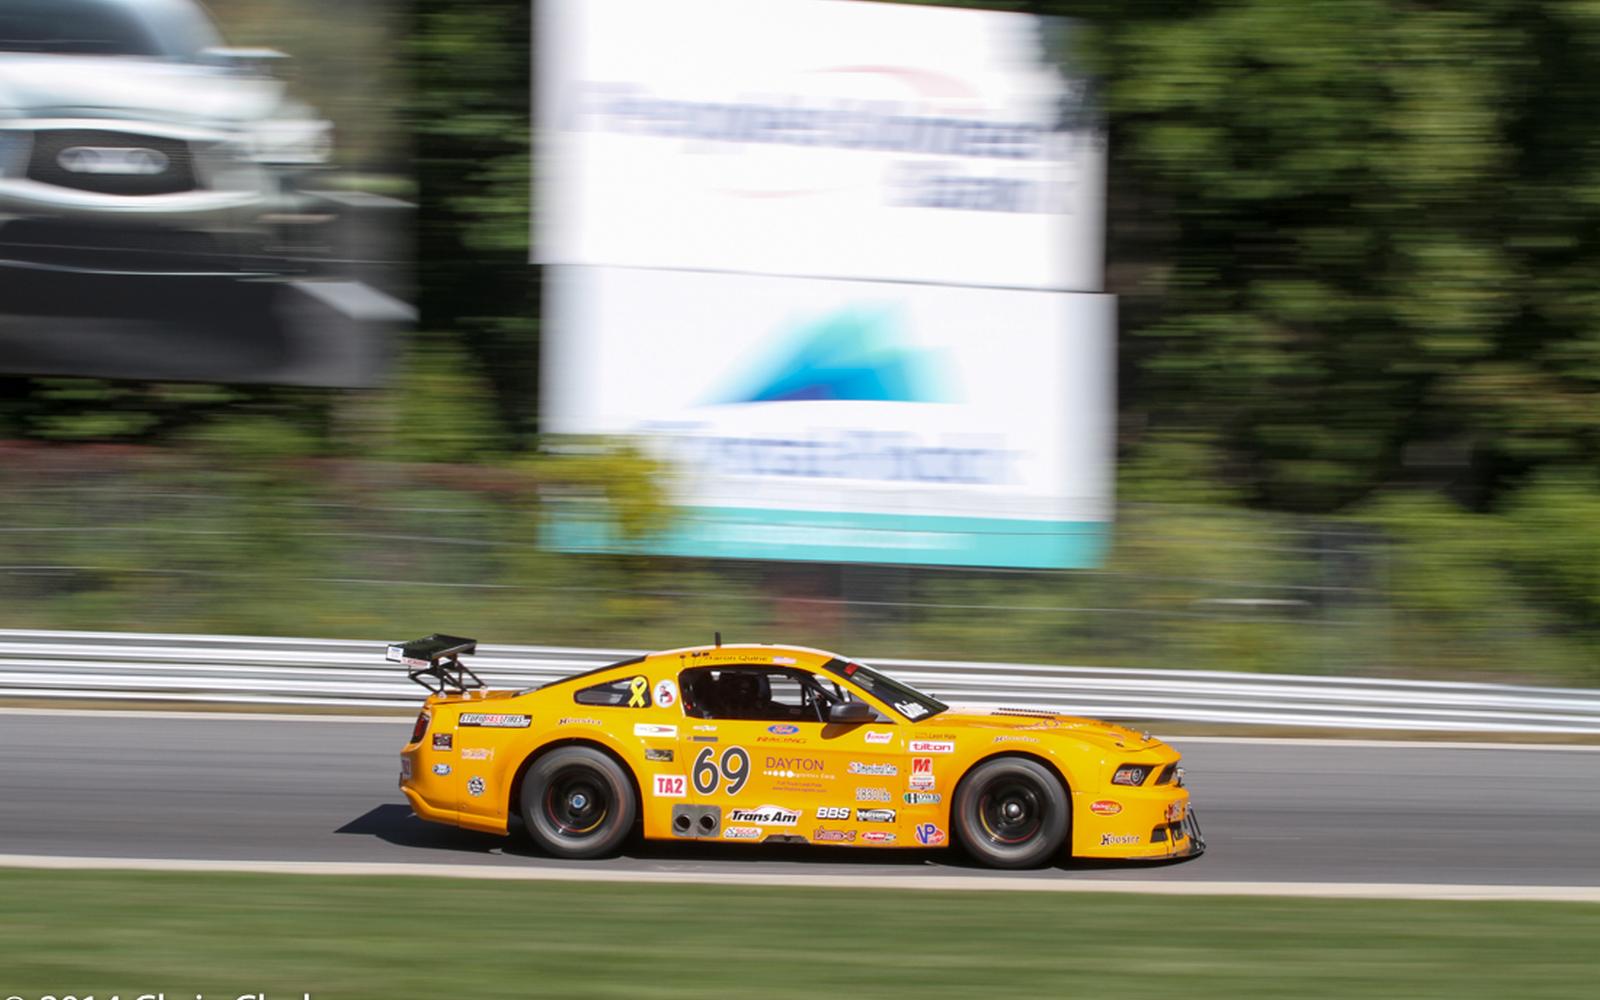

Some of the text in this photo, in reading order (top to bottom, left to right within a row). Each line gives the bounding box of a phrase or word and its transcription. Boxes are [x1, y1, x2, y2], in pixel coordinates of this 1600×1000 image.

[912, 742, 951, 751] tilton
[693, 745, 750, 796] 69
[765, 756, 825, 771] DAYTON
[657, 777, 684, 794] TA2
[732, 810, 797, 823] Trans Am
[816, 807, 850, 820] BBS
[916, 824, 936, 844] VP
[1100, 832, 1140, 846] Hoosier
